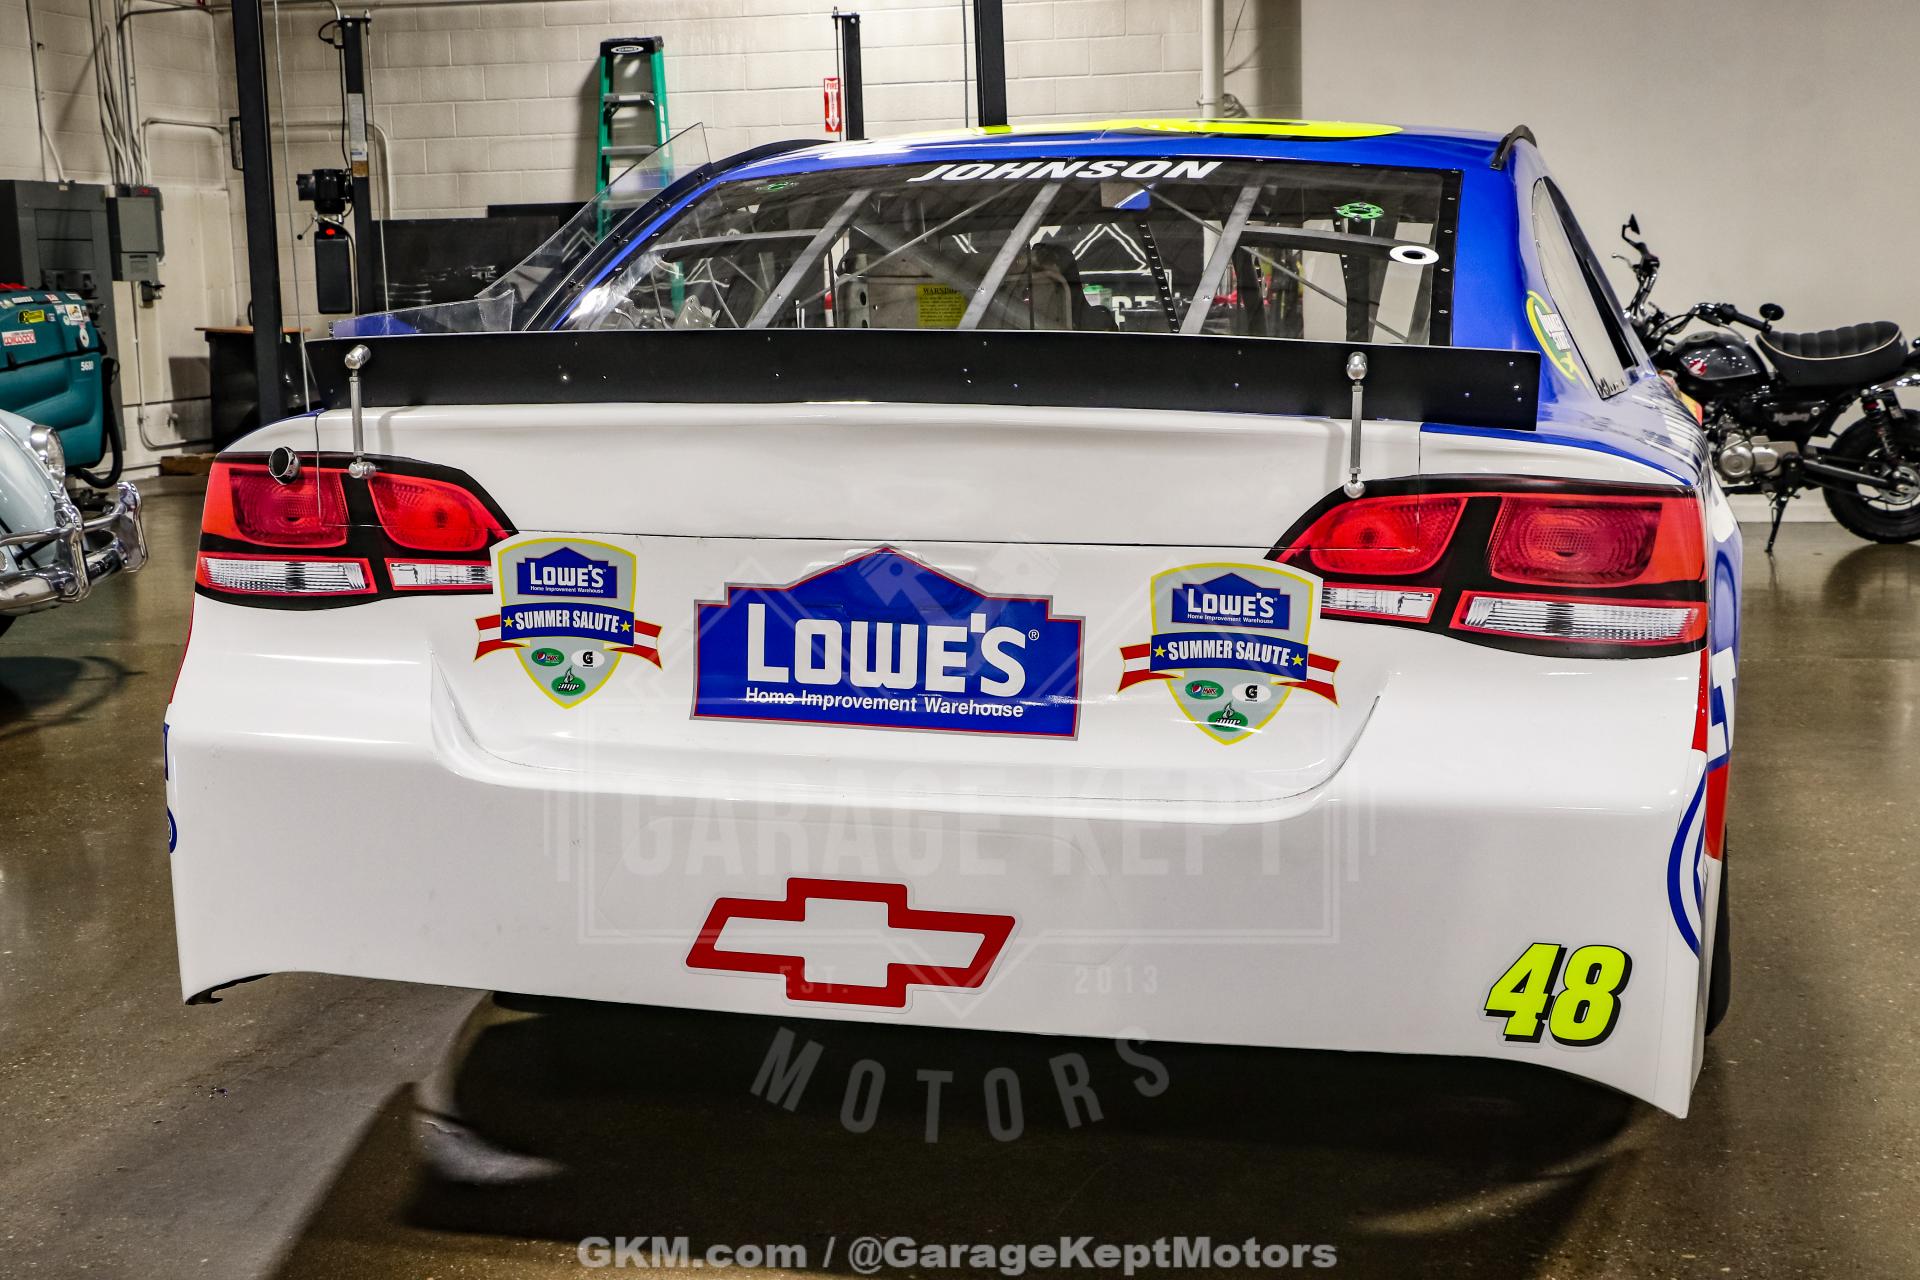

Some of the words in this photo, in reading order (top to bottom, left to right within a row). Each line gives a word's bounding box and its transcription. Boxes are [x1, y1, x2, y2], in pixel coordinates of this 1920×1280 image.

[906, 161, 1223, 182] JOHNSON
[530, 562, 604, 588] LOWE'S
[1188, 588, 1274, 618] LOWE'S
[515, 609, 570, 631] SUMMER
[573, 610, 619, 633] SALUTE
[748, 603, 1026, 698] LOWE'S
[1168, 640, 1233, 661] SUMMER
[1236, 640, 1291, 667] SALUTE
[745, 687, 794, 705] Home
[802, 689, 917, 711] Improvement
[924, 695, 1024, 718] Warehouse
[1483, 942, 1633, 1047] 48
